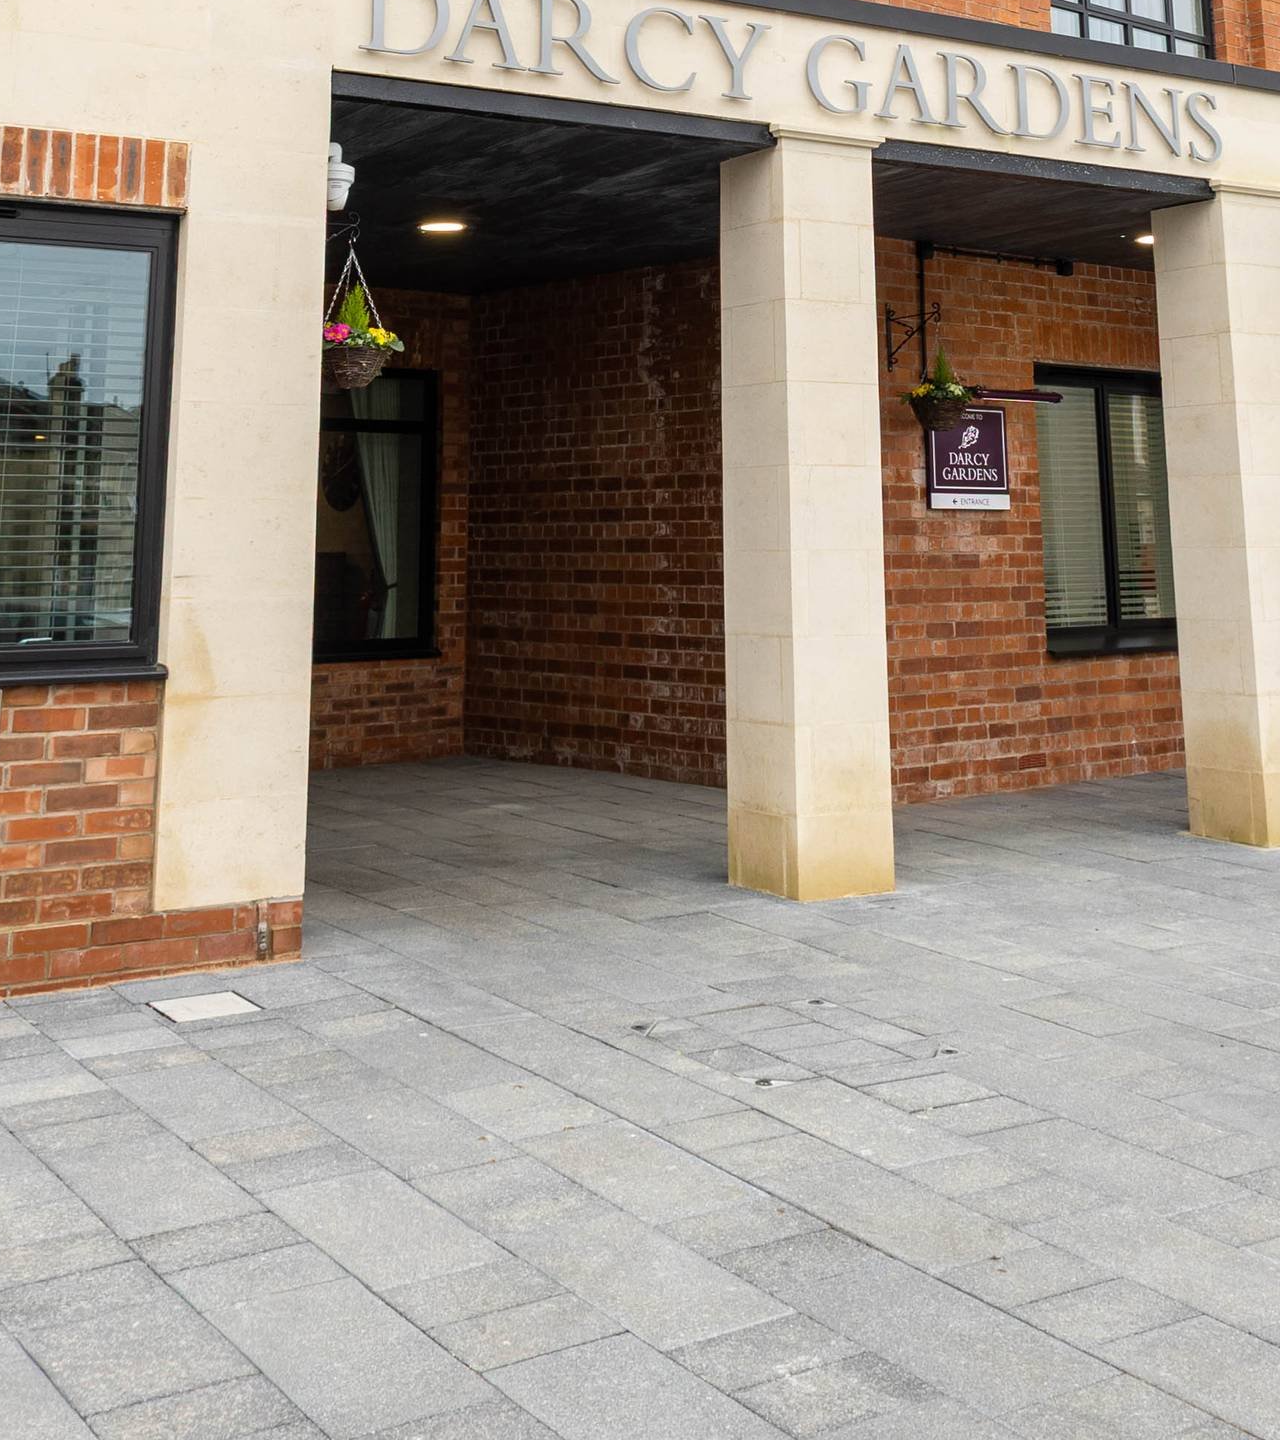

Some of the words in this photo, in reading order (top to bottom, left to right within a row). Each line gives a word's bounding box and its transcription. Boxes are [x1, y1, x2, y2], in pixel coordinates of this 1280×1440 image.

[806, 34, 1223, 162] GARDENS
[949, 452, 990, 466] DARCY
[942, 467, 998, 481] GARDENS
[960, 497, 990, 506] ENTRANCE
